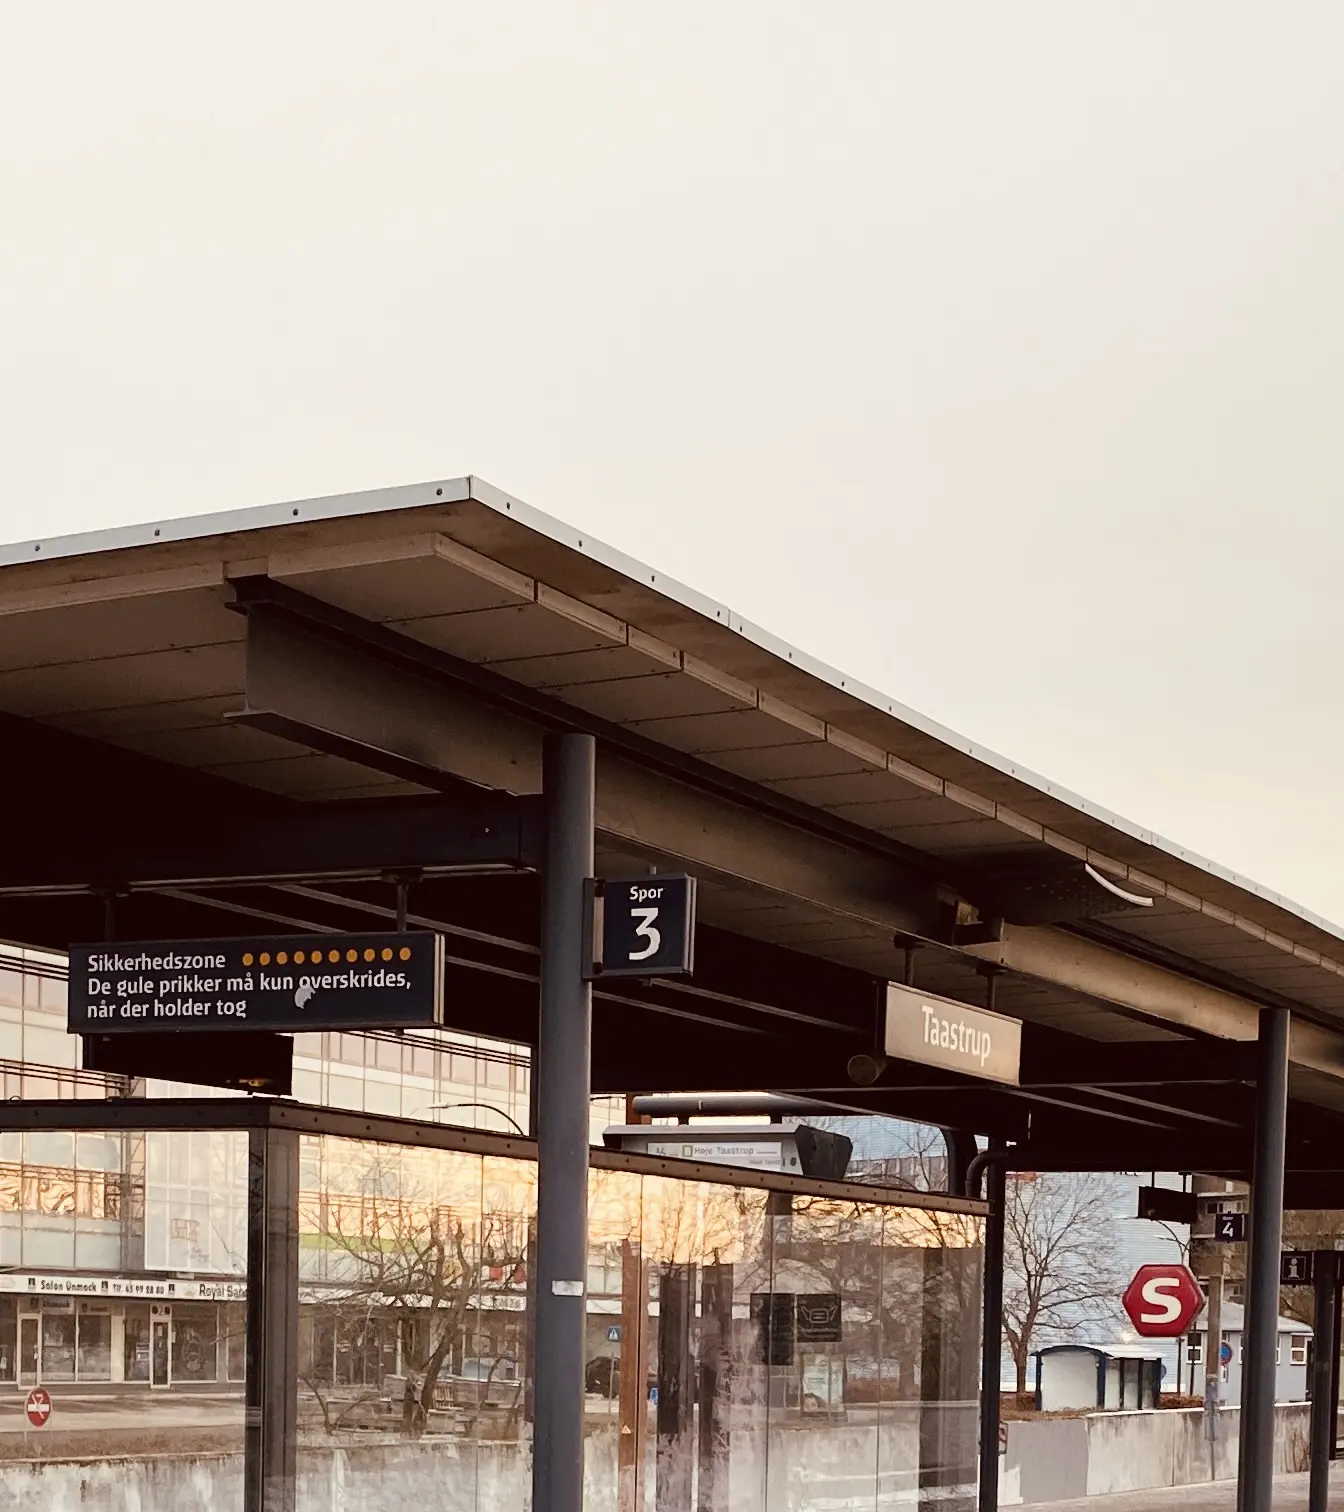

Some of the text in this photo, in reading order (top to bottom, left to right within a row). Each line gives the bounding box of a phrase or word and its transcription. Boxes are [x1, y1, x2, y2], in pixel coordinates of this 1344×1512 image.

[629, 885, 664, 903] Spor
[628, 907, 661, 960] 3
[87, 951, 226, 972] Sikkerhedszone
[87, 968, 412, 998] De gule prikker må kun overskrides,
[87, 998, 247, 1019] når der holder tog
[921, 1004, 991, 1067] Taastrup
[716, 1146, 755, 1157] Taastrup
[1222, 1222, 1234, 1237] 4
[40, 1279, 63, 1291] Salon
[199, 1283, 225, 1298] Royal
[1140, 1277, 1182, 1324] S
